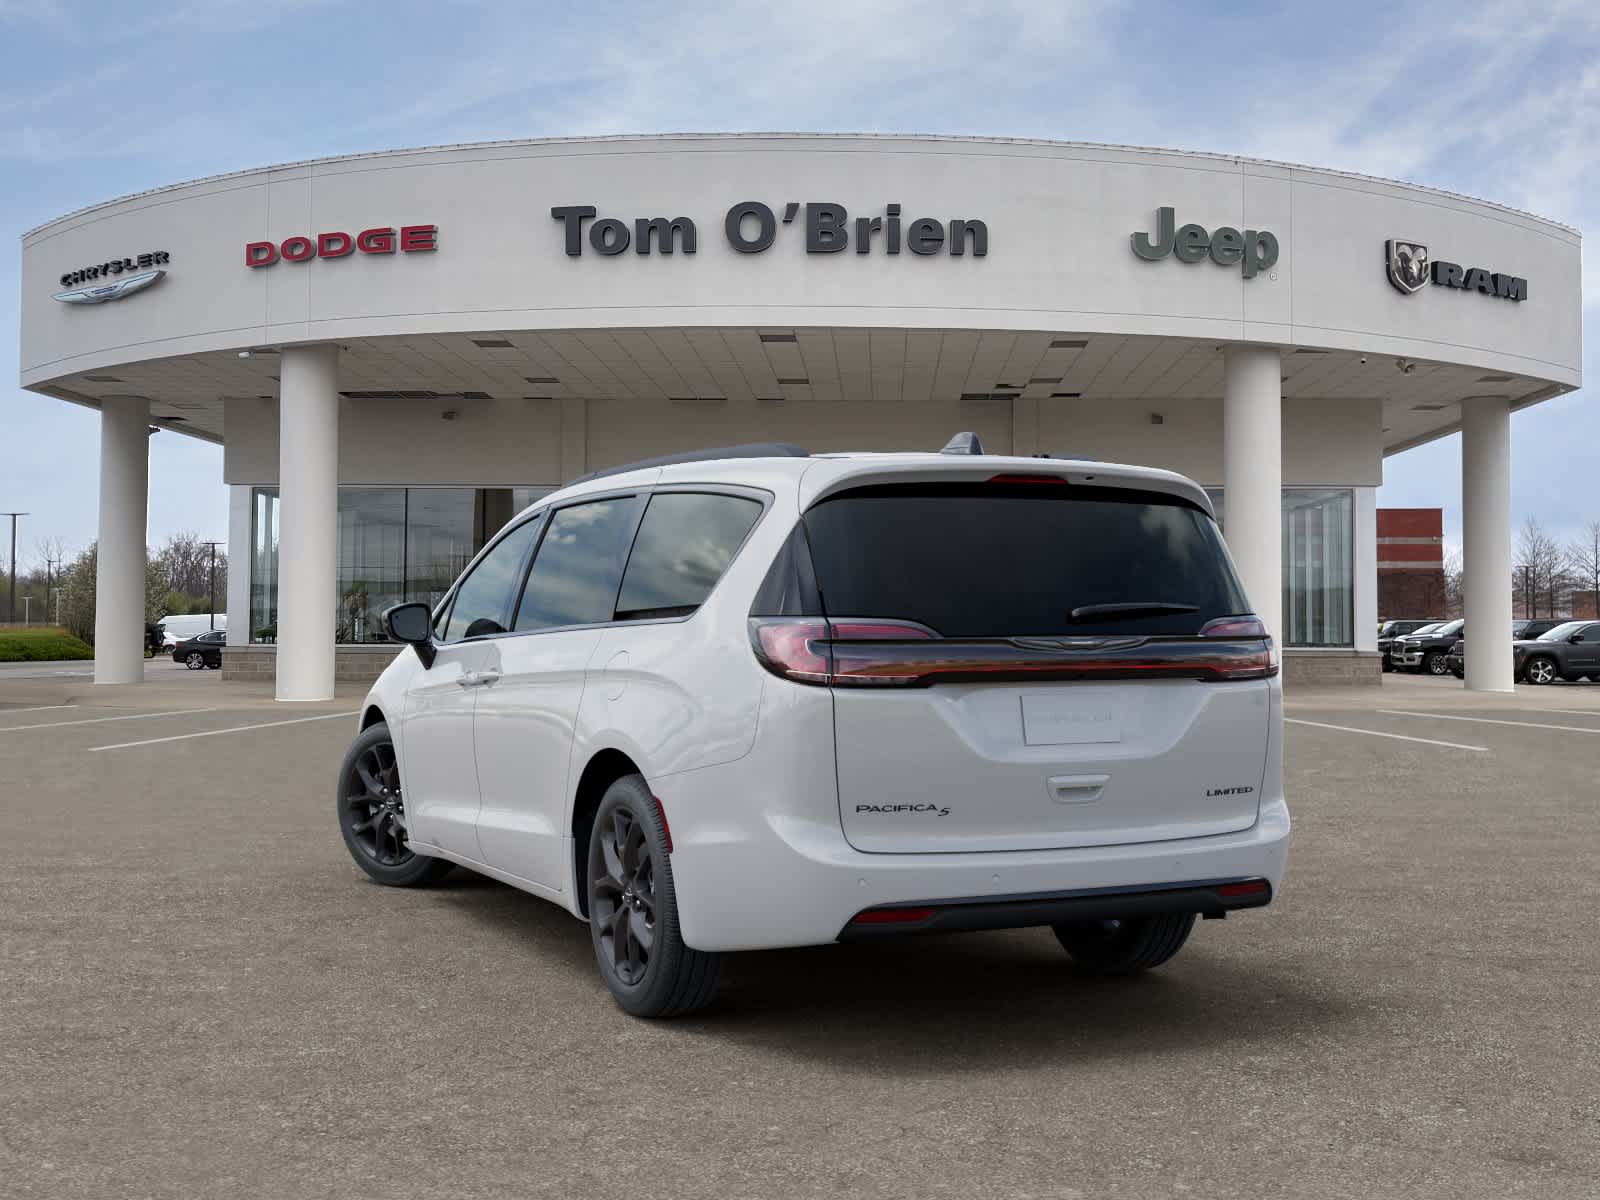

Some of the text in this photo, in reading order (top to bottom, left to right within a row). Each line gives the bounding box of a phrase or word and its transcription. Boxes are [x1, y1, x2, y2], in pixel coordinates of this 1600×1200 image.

[246, 224, 439, 268] DODGE
[550, 204, 697, 256] Tom
[1130, 206, 1280, 279] Jeep
[60, 249, 170, 287] CHRYSLER
[1431, 260, 1528, 302] RAM
[855, 803, 938, 814] PACIFICA
[1206, 786, 1254, 797] LIMITED
